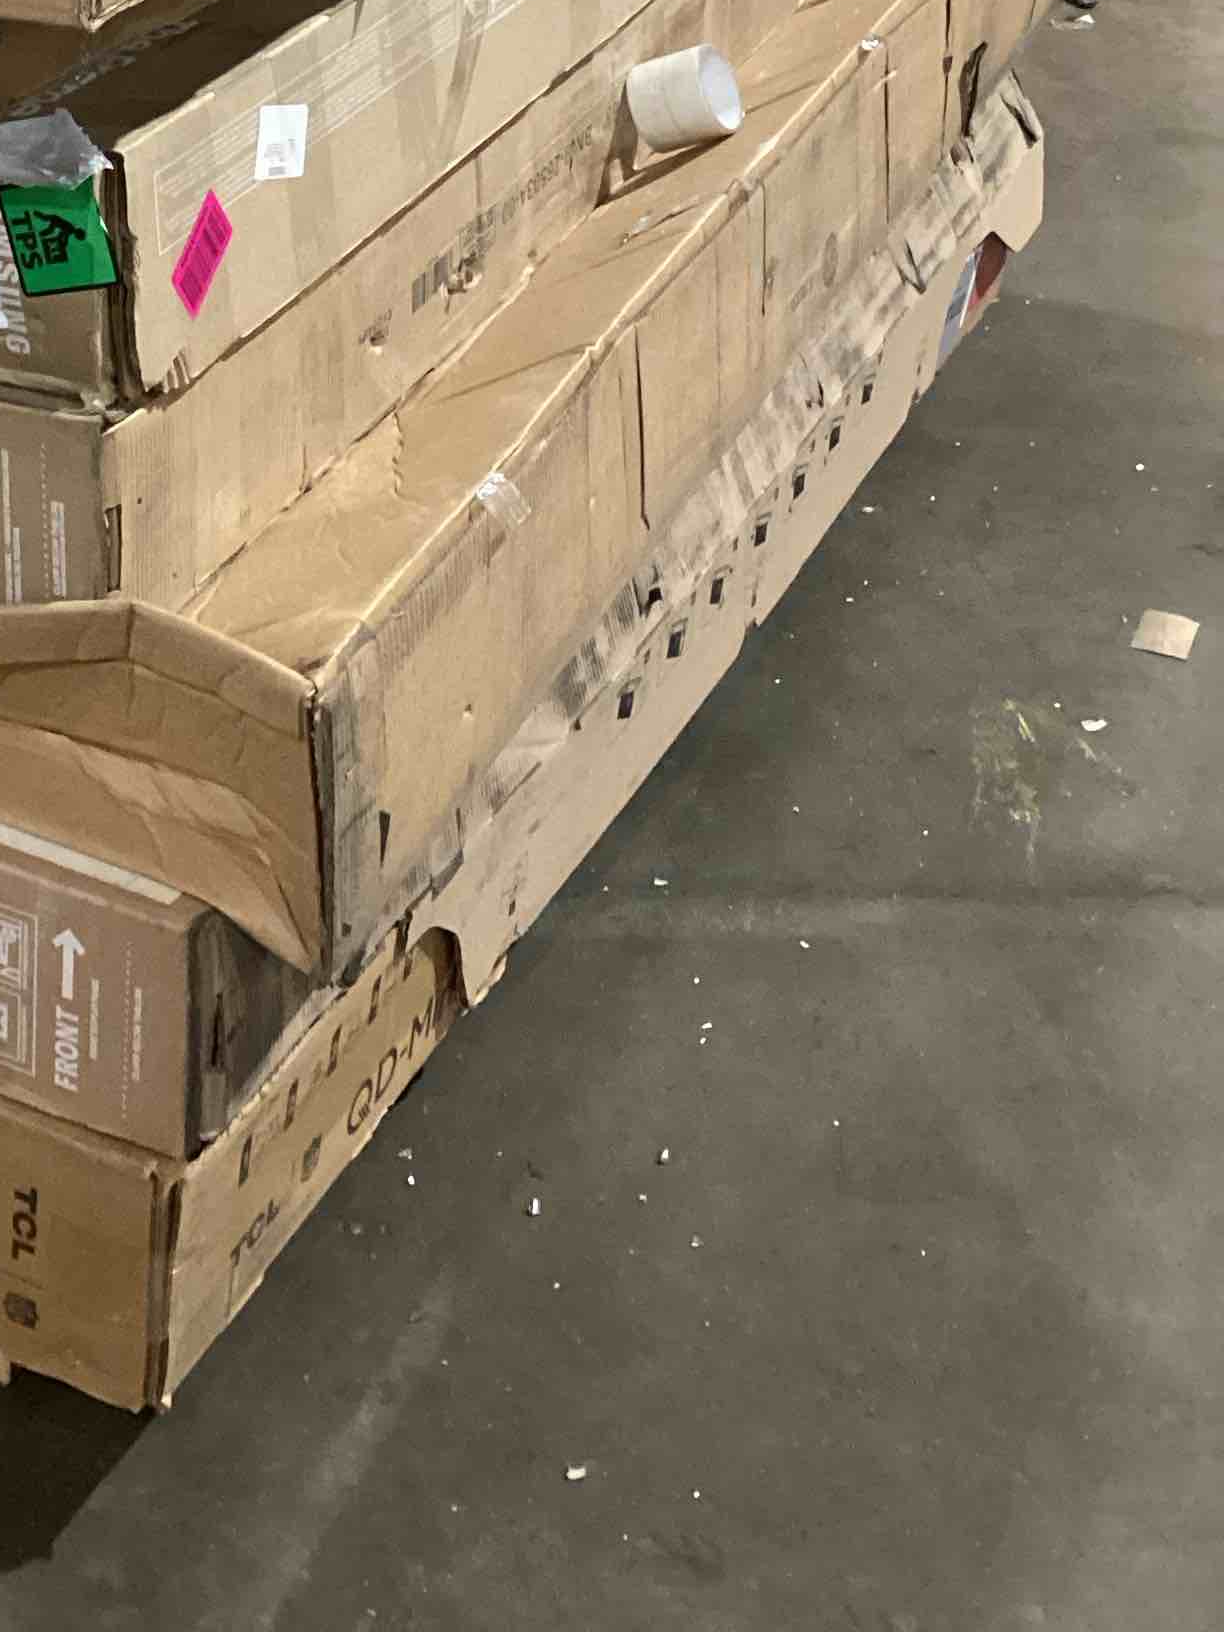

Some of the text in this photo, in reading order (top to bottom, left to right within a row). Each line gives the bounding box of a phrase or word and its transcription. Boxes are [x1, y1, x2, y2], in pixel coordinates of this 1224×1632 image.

[11, 209, 45, 270] TPS
[54, 1004, 82, 1093] FRONT
[11, 1187, 39, 1261] TCL
